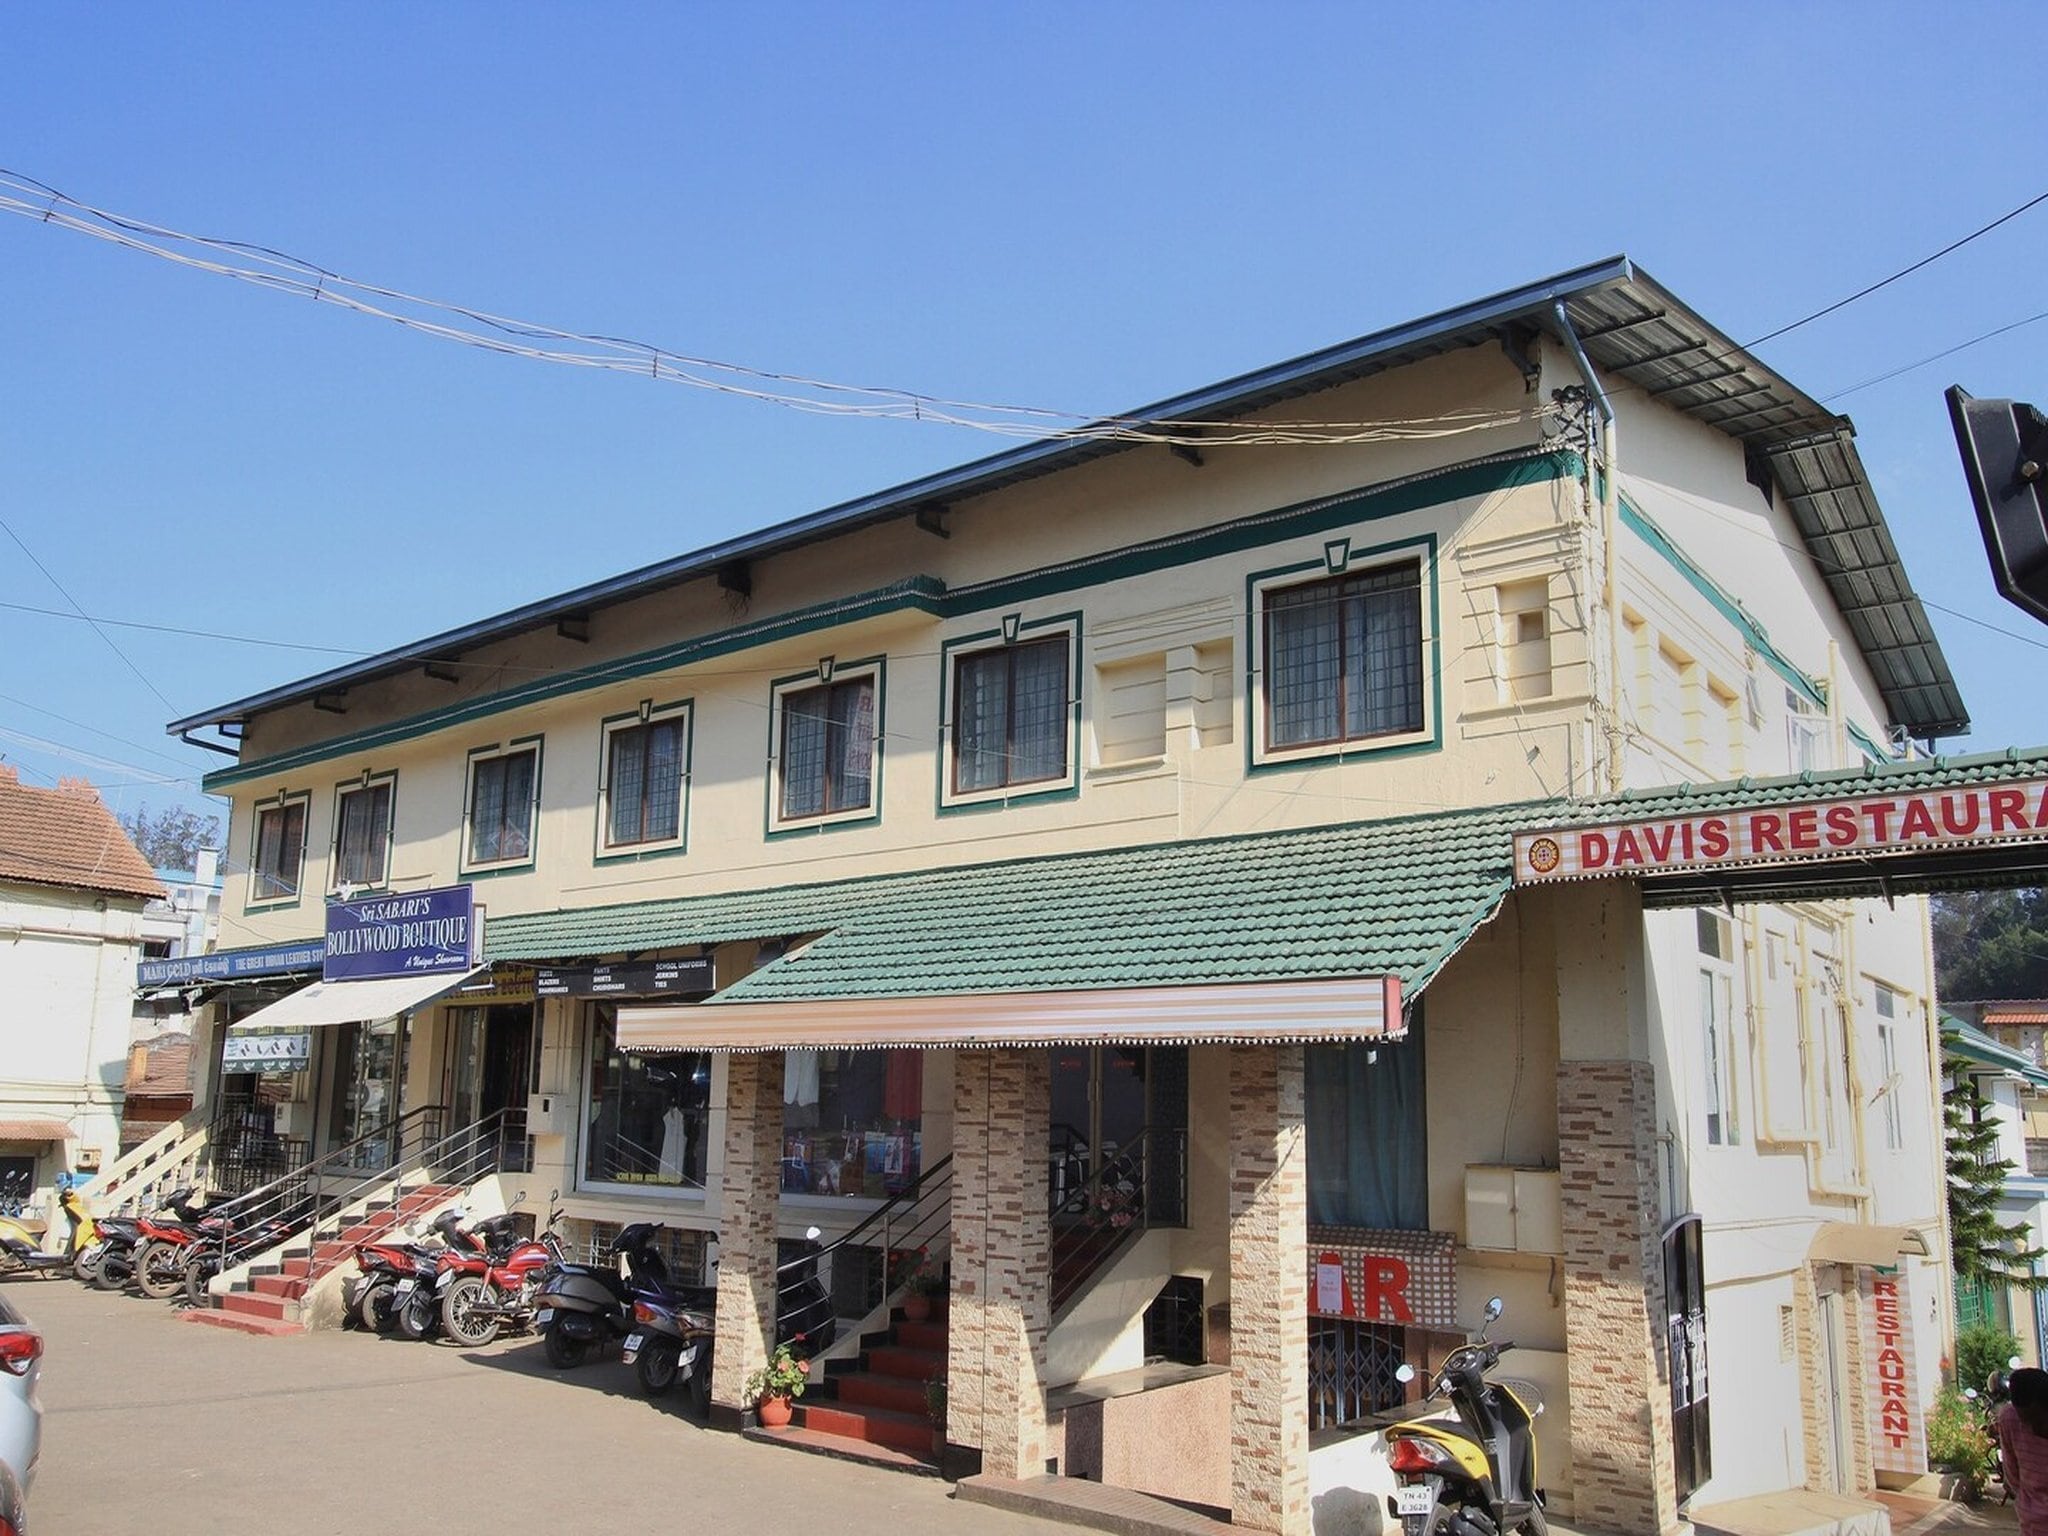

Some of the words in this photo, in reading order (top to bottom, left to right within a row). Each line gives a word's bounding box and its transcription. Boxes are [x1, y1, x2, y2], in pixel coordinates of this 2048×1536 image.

[1581, 819, 1732, 869] DAVIS
[1750, 786, 2048, 851] RESTAUR
[327, 924, 399, 956] BOLLYWOOD
[402, 916, 467, 950] BOUTIQUE
[360, 905, 375, 922] Sri
[376, 897, 431, 919] SABARI'S
[1874, 1281, 1909, 1448] RESTAURANT
